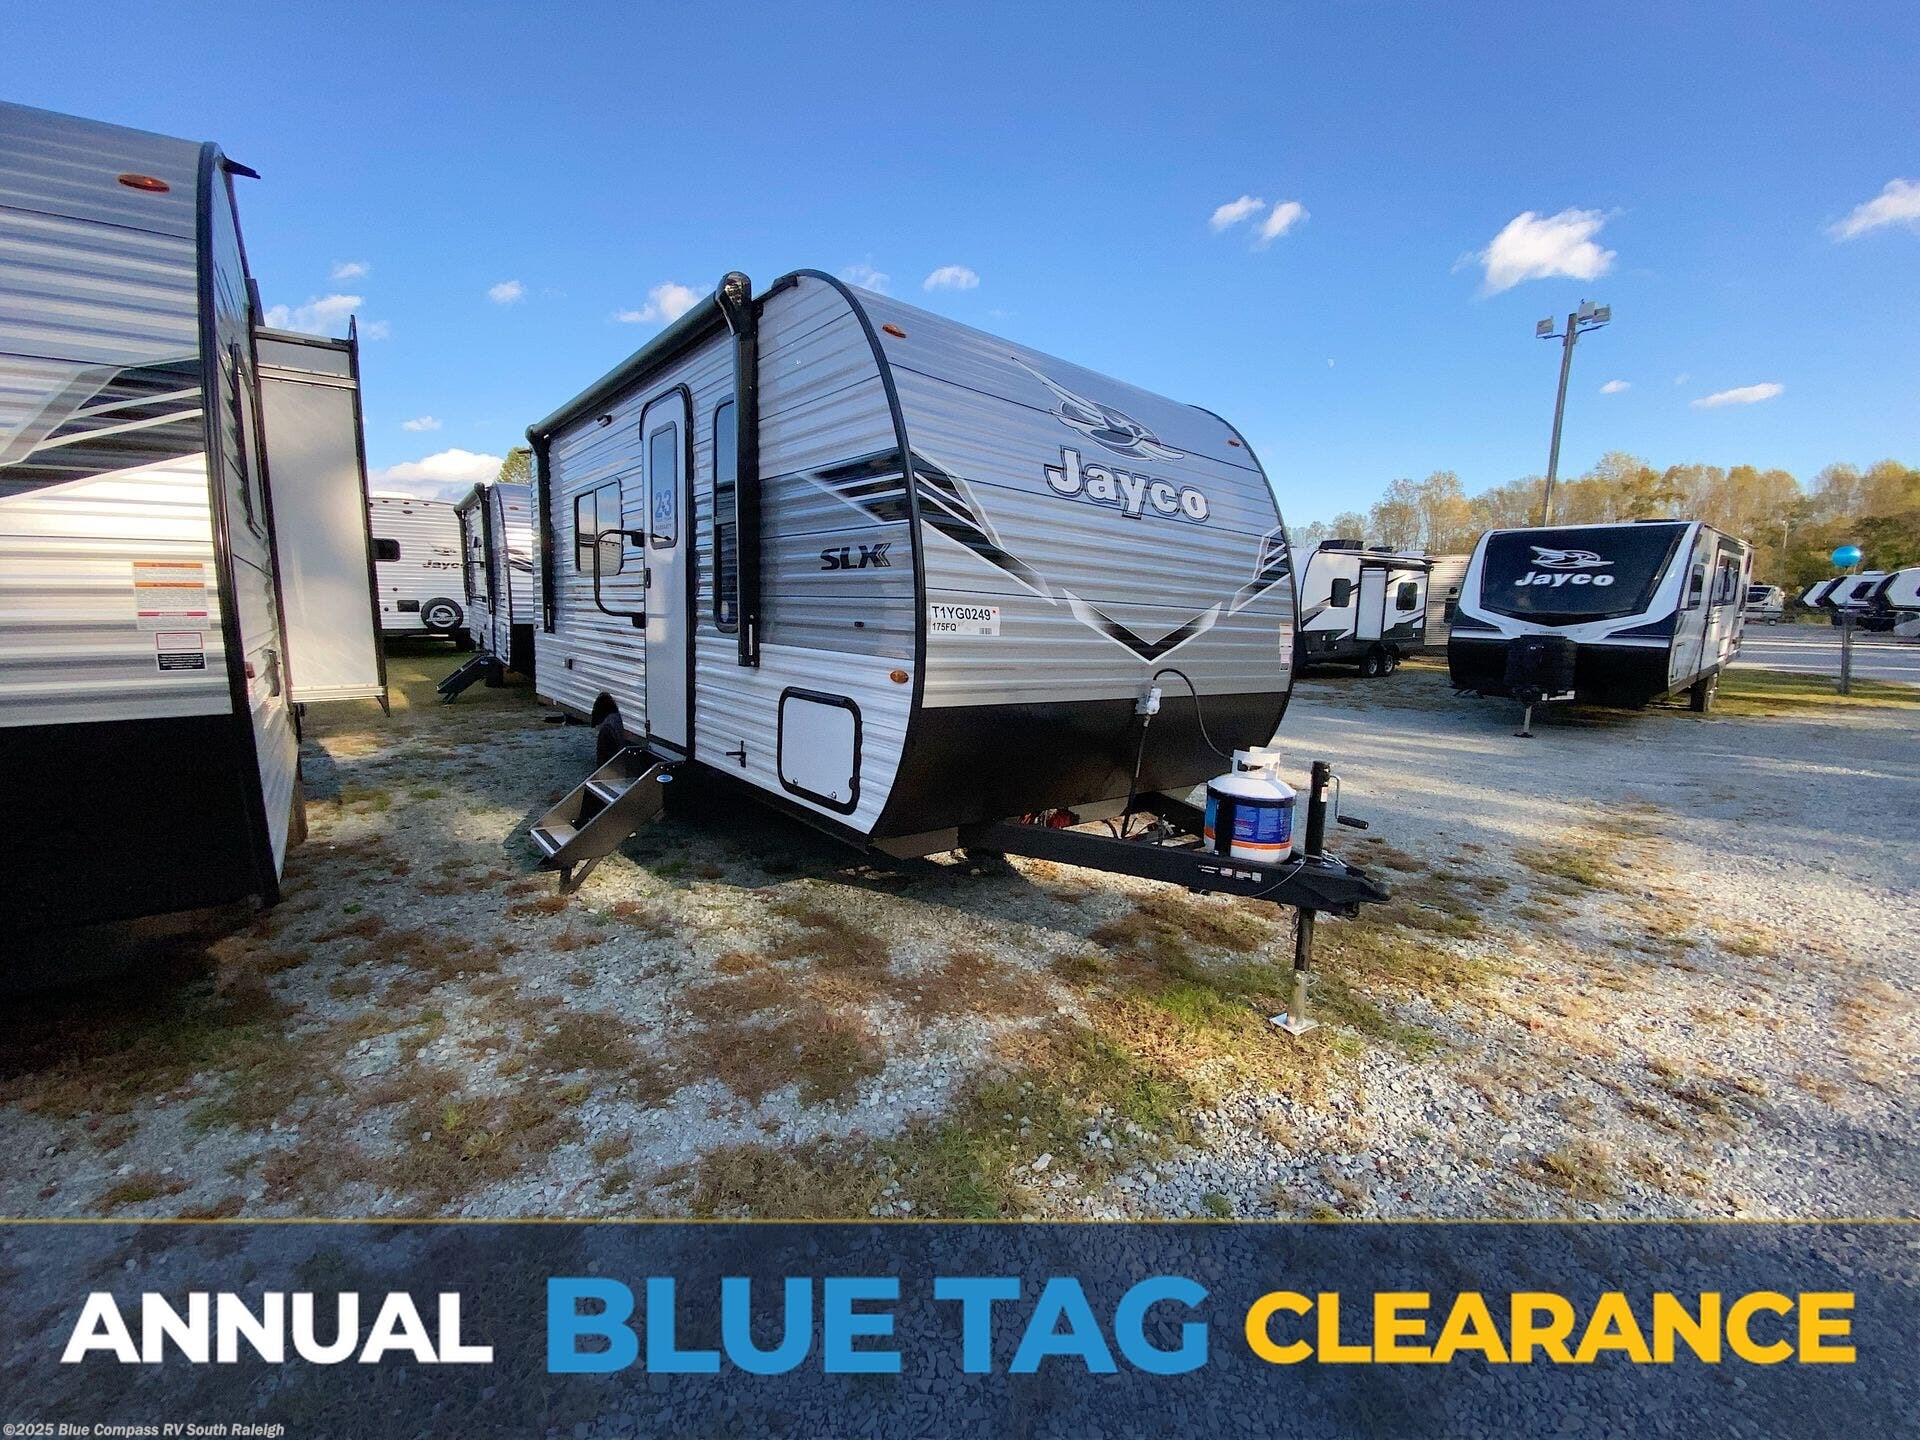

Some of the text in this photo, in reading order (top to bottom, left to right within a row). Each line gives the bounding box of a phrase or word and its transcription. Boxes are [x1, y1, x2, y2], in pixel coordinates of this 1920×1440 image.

[1044, 445, 1210, 523] Jayco
[820, 543, 892, 570] SLX
[1515, 571, 1615, 588] Jayco
[931, 605, 991, 620] T1YG0249
[932, 623, 957, 632] 175FQ
